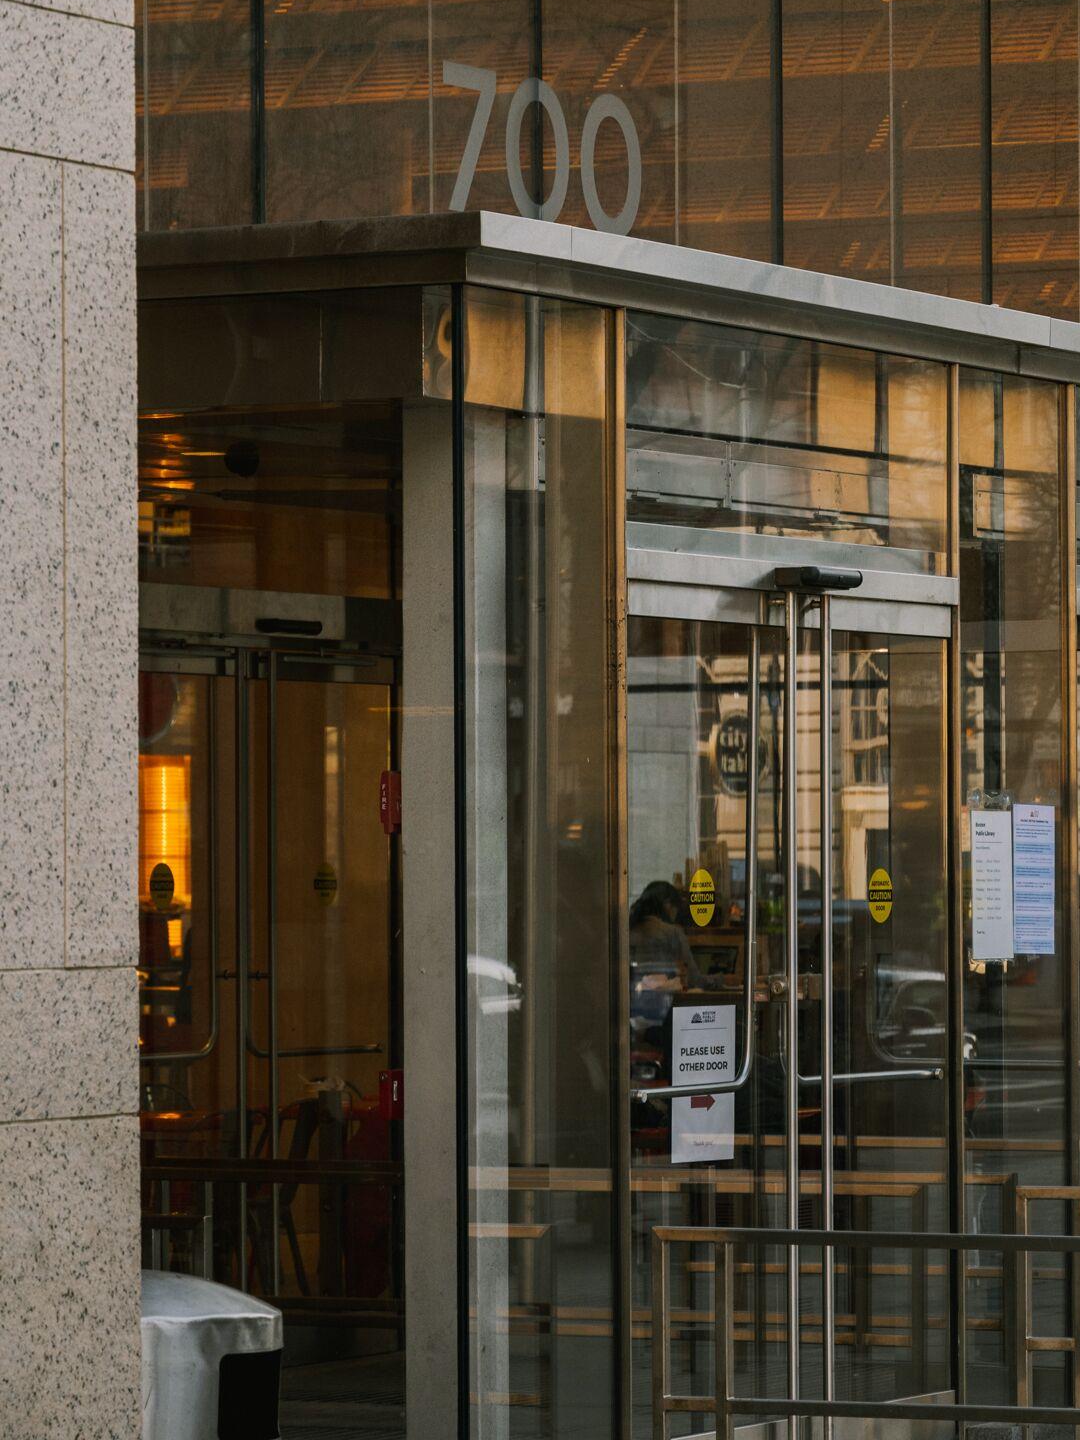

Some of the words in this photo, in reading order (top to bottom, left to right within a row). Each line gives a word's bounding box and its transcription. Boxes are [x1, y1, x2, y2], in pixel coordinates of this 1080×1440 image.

[443, 60, 641, 237] 700
[691, 893, 714, 903] CAUTION
[870, 891, 892, 901] CAUTION
[681, 1047, 709, 1056] PLEASE
[710, 1046, 725, 1055] USE
[679, 1062, 705, 1072] OTHER
[706, 1061, 728, 1071] DOOR
